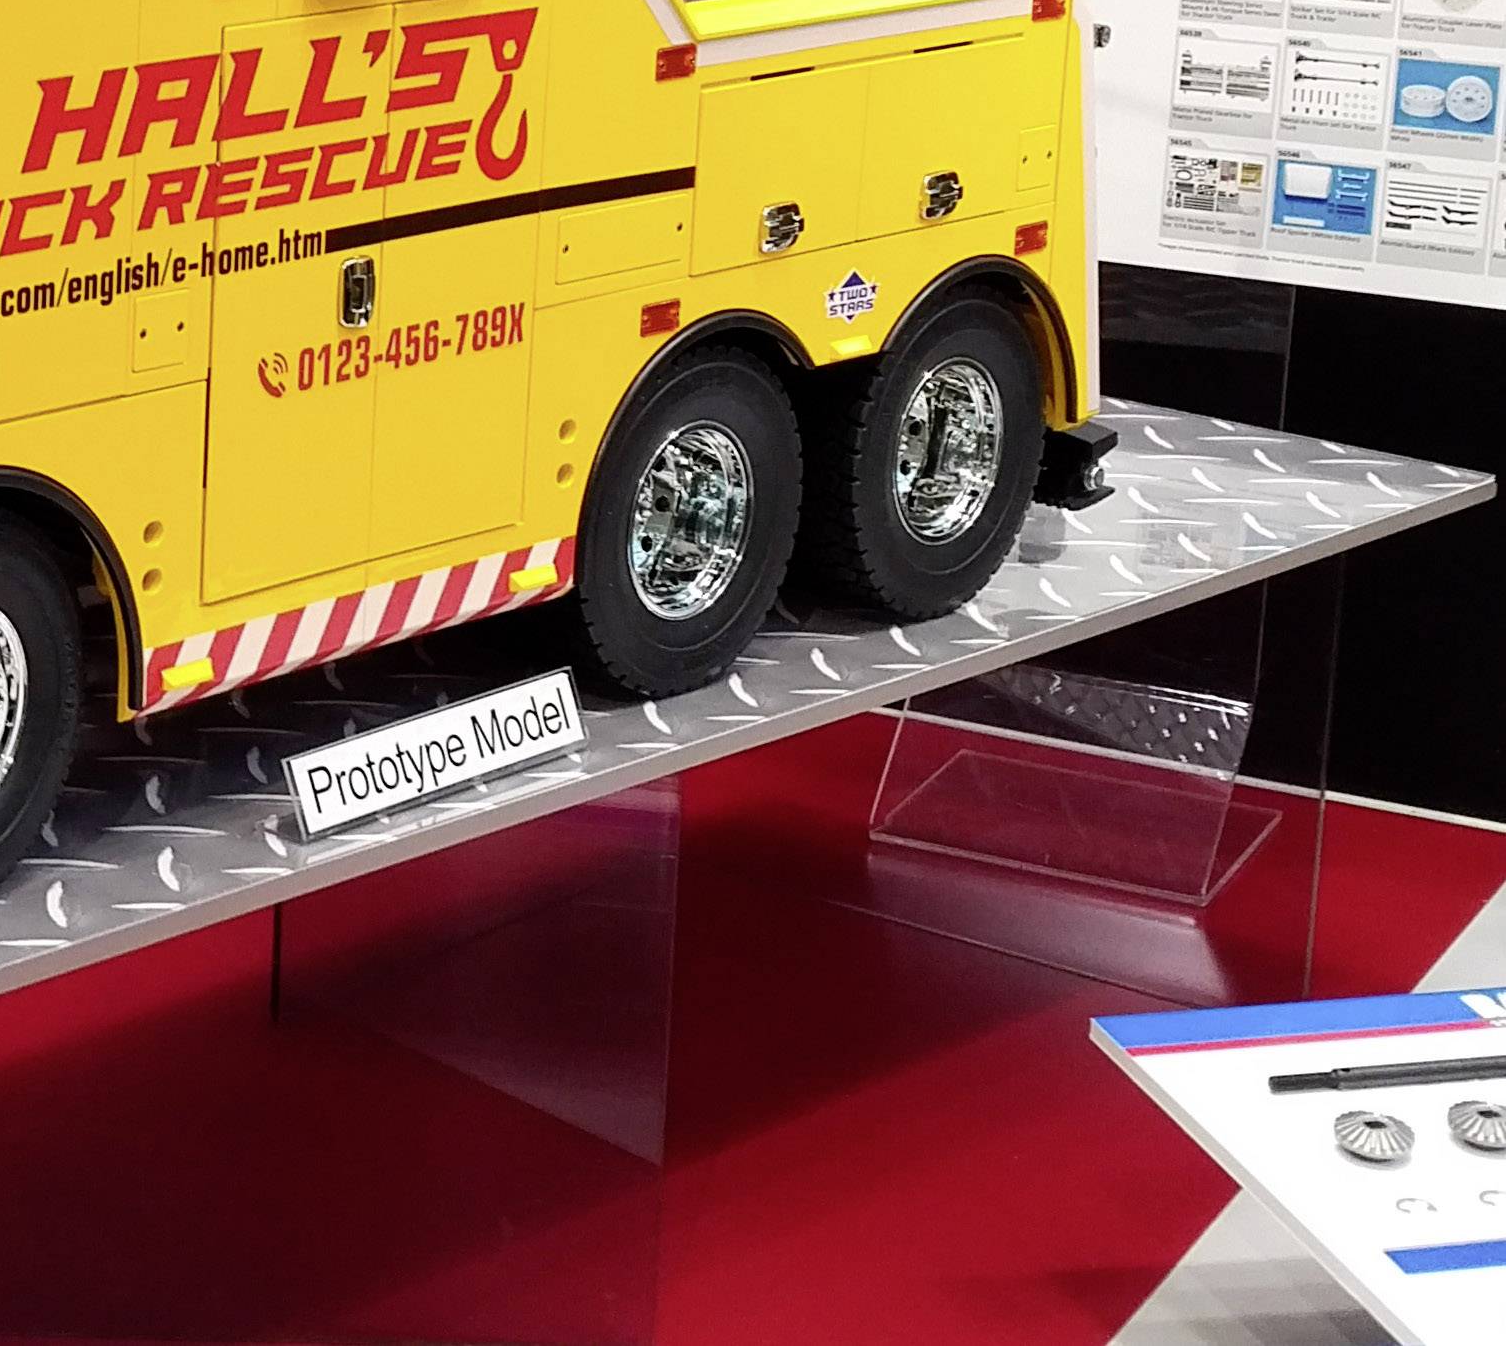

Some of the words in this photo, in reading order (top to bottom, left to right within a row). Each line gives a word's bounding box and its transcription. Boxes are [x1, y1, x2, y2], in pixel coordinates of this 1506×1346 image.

[21, 8, 517, 173] HALL'S
[137, 120, 474, 231] RESCUE
[829, 299, 875, 316] STARS
[839, 288, 867, 302] TWO
[297, 302, 525, 392] 0123-456-789X
[307, 732, 467, 814] Prototype
[470, 687, 571, 758] Model
